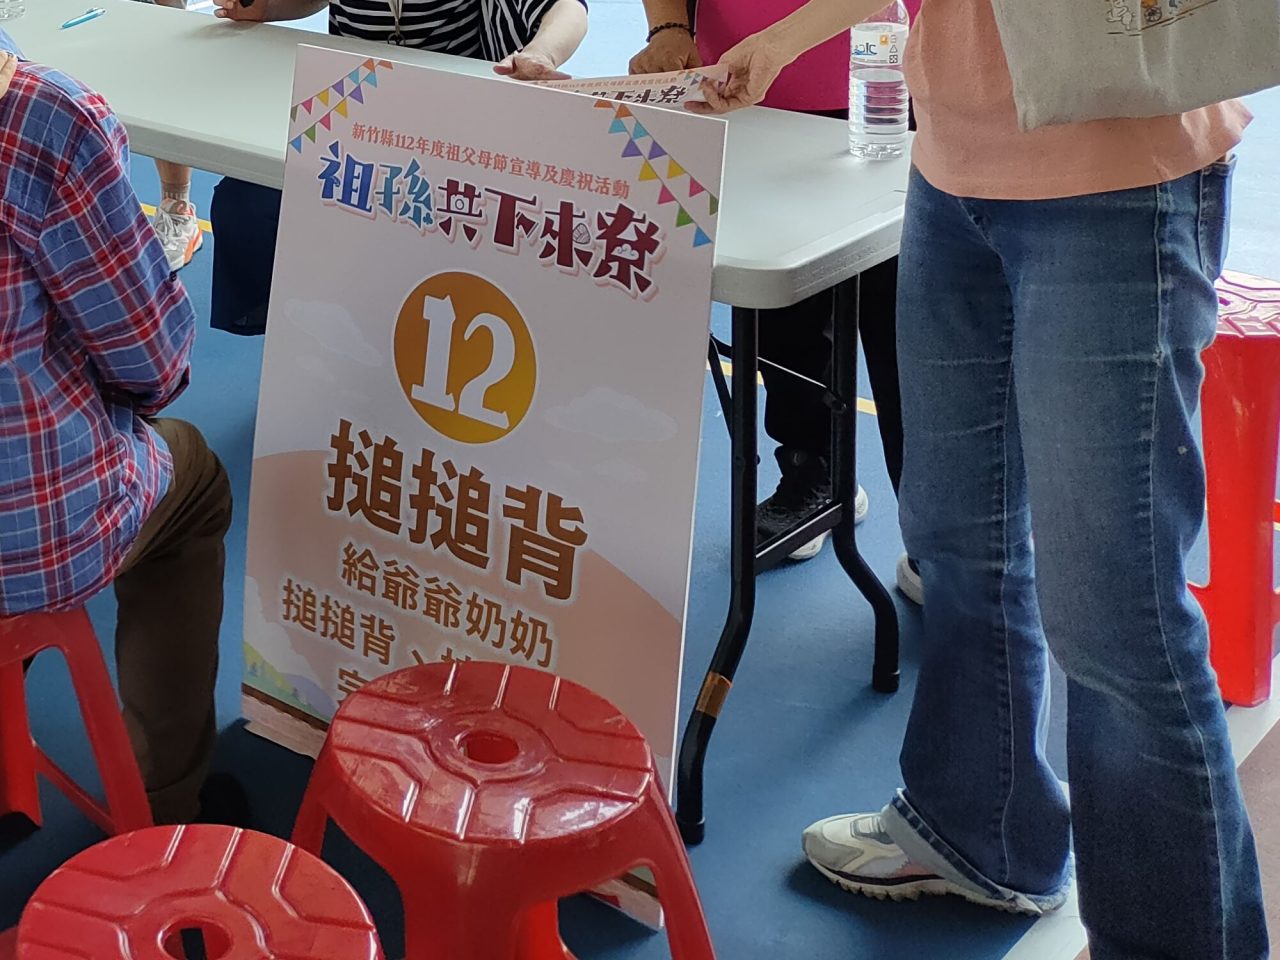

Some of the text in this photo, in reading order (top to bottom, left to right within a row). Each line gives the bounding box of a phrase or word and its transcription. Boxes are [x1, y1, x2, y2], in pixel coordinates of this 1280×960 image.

[351, 122, 631, 200] 新竹縣112年度祖父母節宣導及慶祝活動
[410, 294, 516, 429] 12
[326, 418, 589, 601] 搥搥背
[341, 542, 554, 668] 給爺爺奶奶
